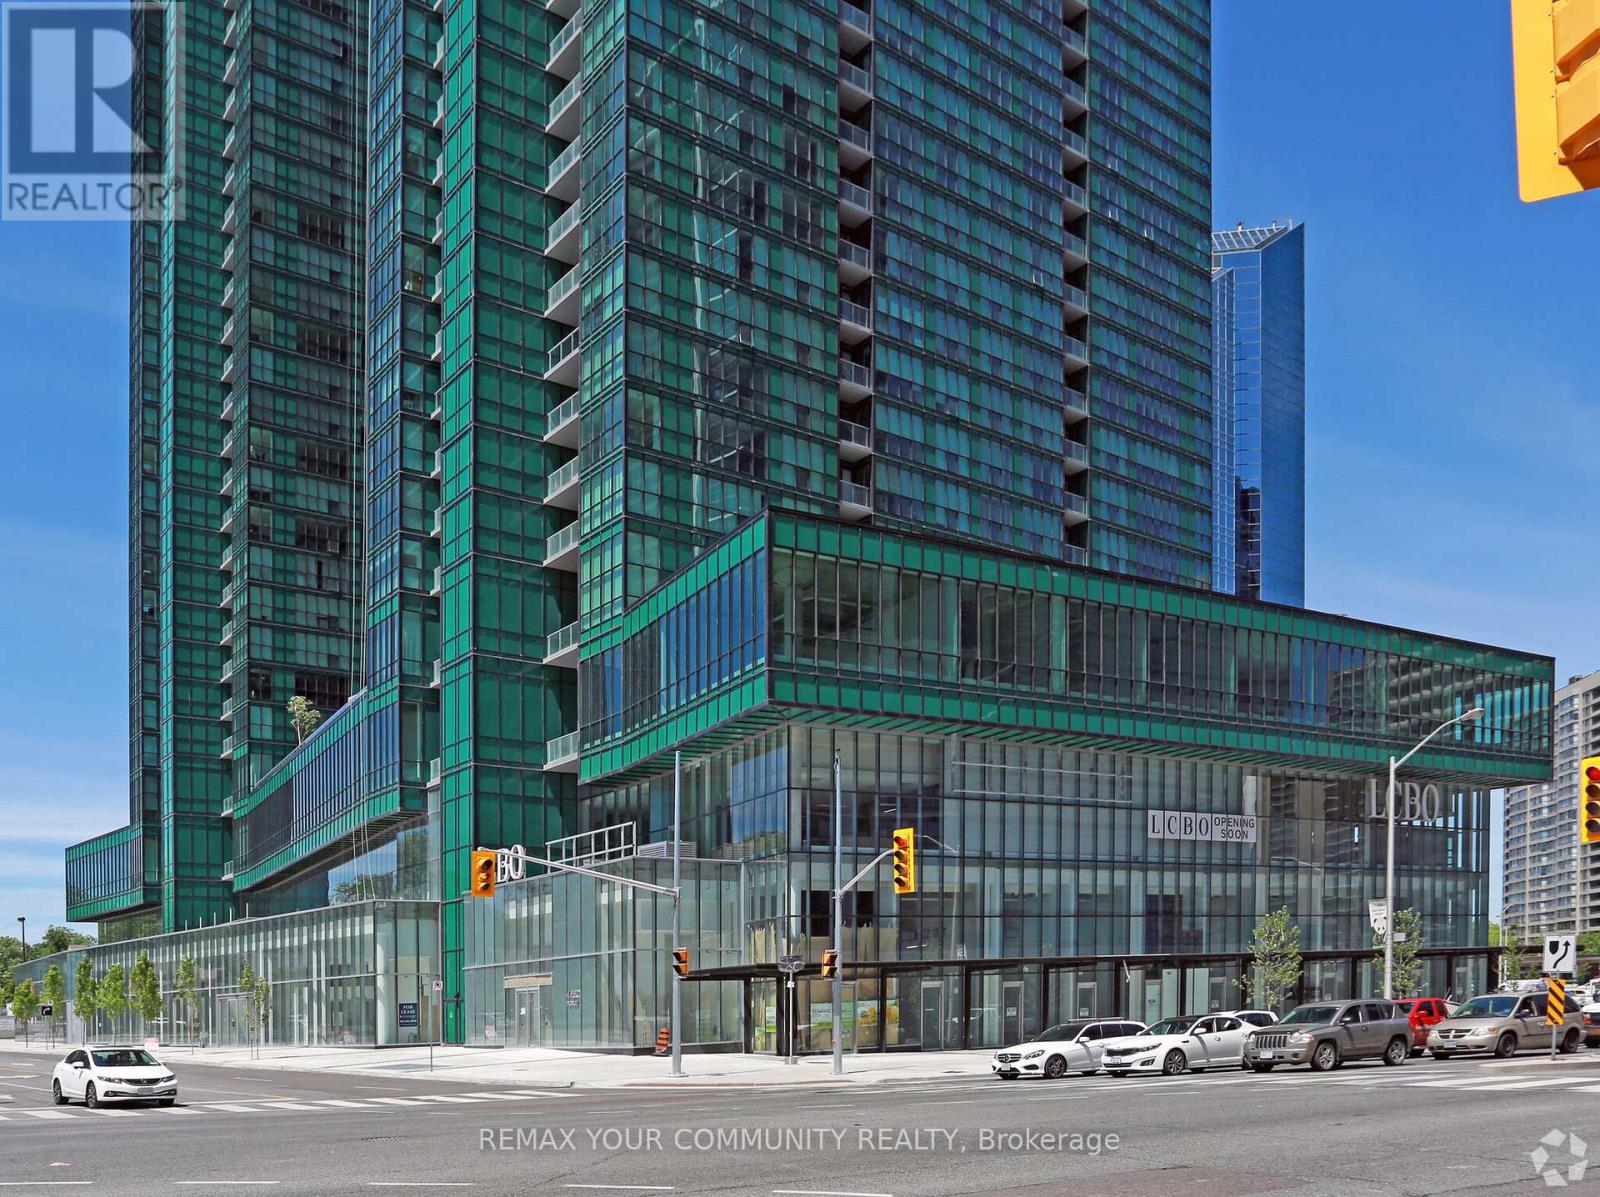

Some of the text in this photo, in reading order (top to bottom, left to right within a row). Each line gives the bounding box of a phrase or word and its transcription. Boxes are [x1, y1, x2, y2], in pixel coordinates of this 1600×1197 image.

[1369, 778, 1440, 822] LCBO
[1151, 814, 1209, 836] LCBO
[1213, 816, 1255, 829] OPENING
[1220, 828, 1248, 839] SOON
[496, 844, 525, 883] BO
